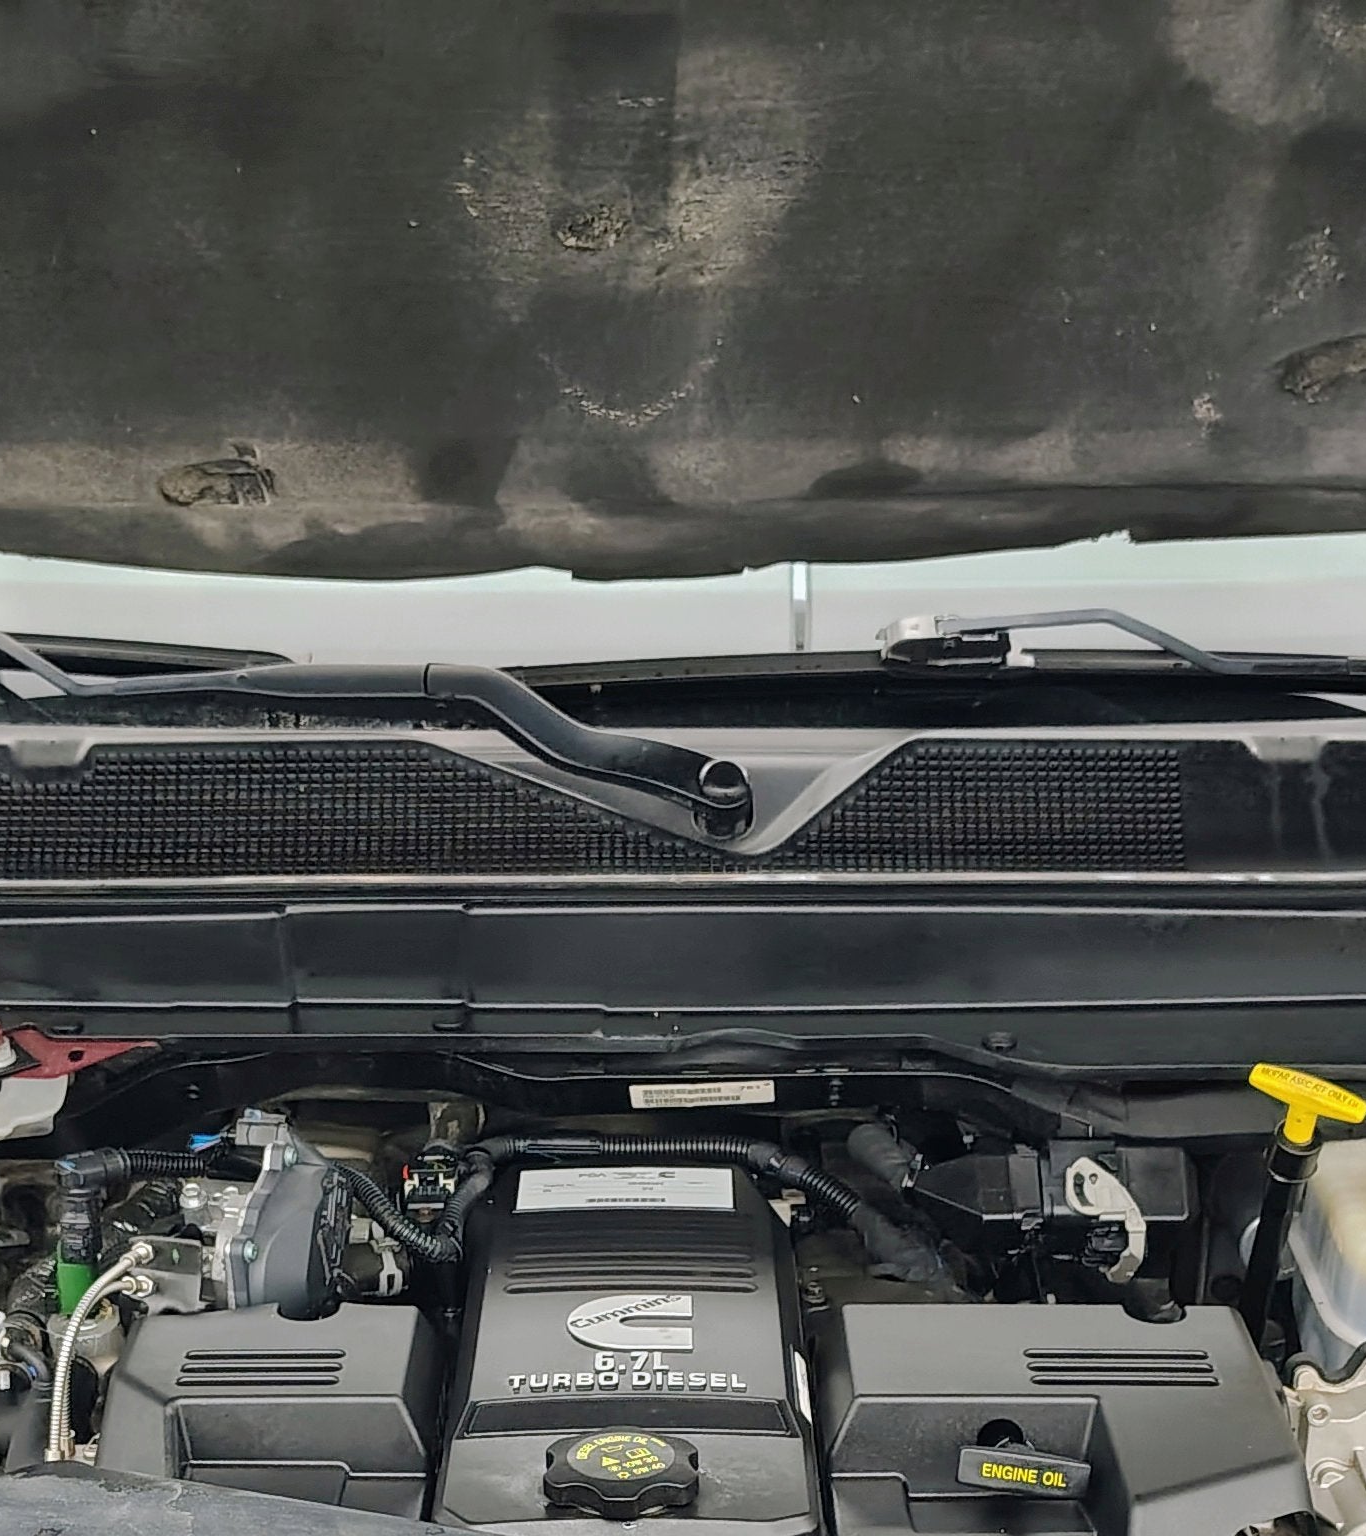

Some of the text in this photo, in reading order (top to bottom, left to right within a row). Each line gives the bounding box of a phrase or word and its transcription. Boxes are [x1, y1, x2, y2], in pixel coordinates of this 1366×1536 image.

[594, 1351, 670, 1374] 6.7L
[508, 1371, 748, 1393] TURBO DIESEL
[981, 1462, 1067, 1487] ENGINE OIL
